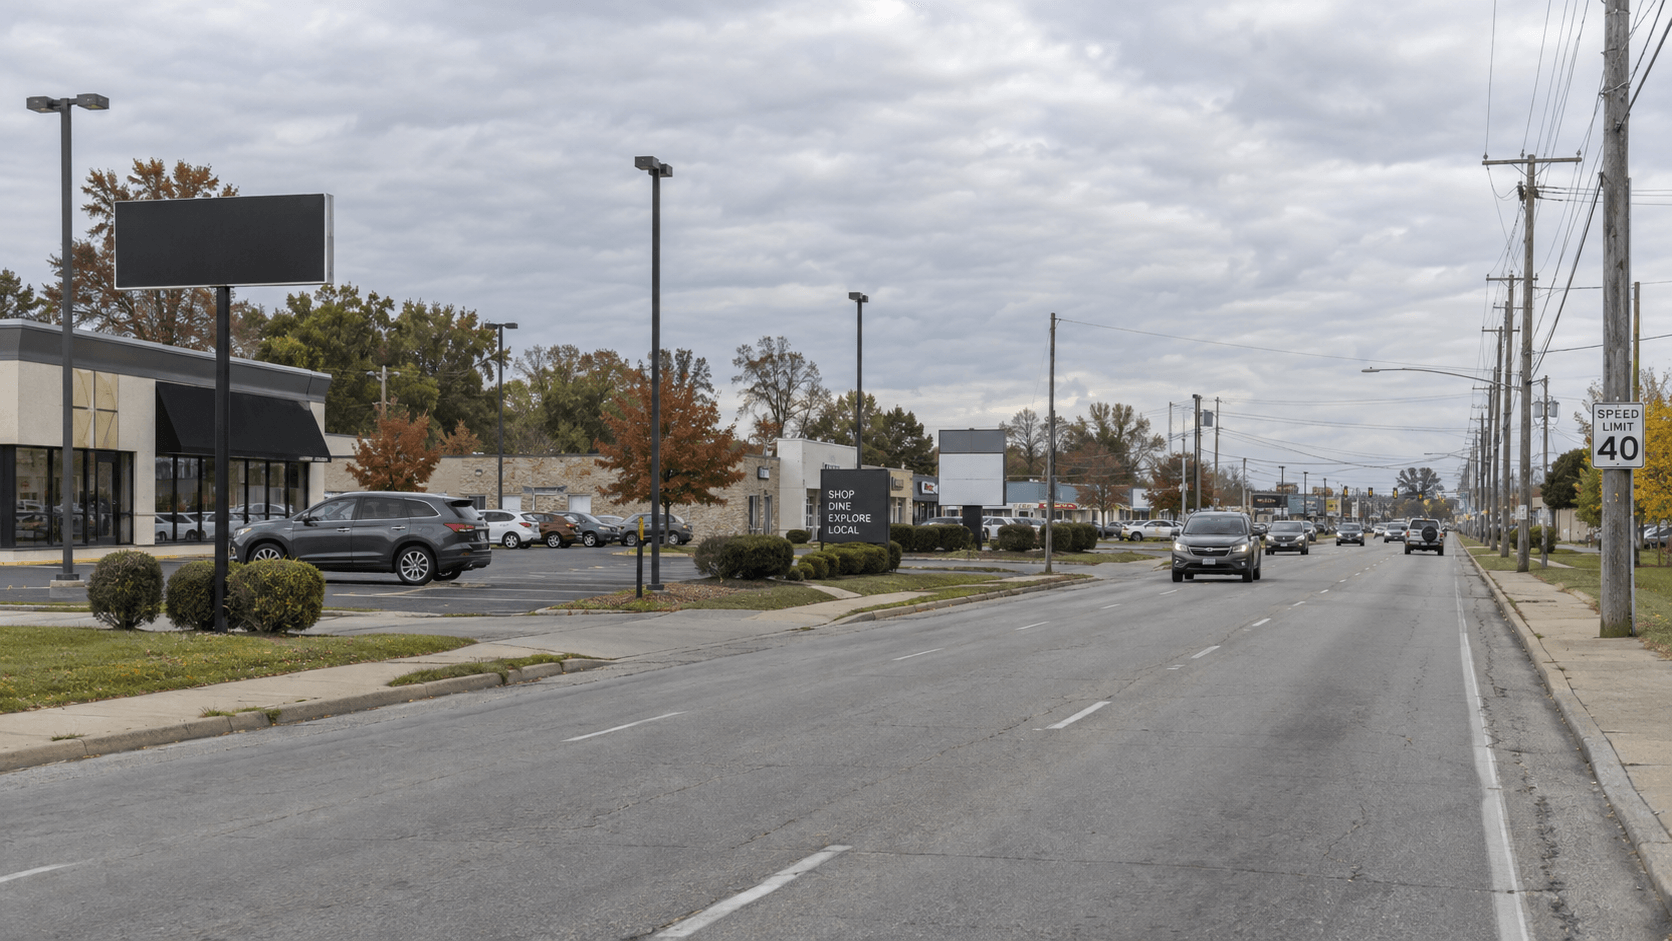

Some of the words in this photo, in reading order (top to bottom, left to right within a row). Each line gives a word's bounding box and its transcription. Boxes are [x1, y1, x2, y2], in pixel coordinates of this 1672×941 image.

[1597, 409, 1639, 419] SPEED
[1602, 422, 1634, 431] LIMIT
[1597, 436, 1639, 461] 40
[828, 490, 855, 499] SHOP
[828, 502, 851, 511] DINE
[828, 514, 871, 523] EXPLORE
[828, 525, 859, 534] LOCAL
